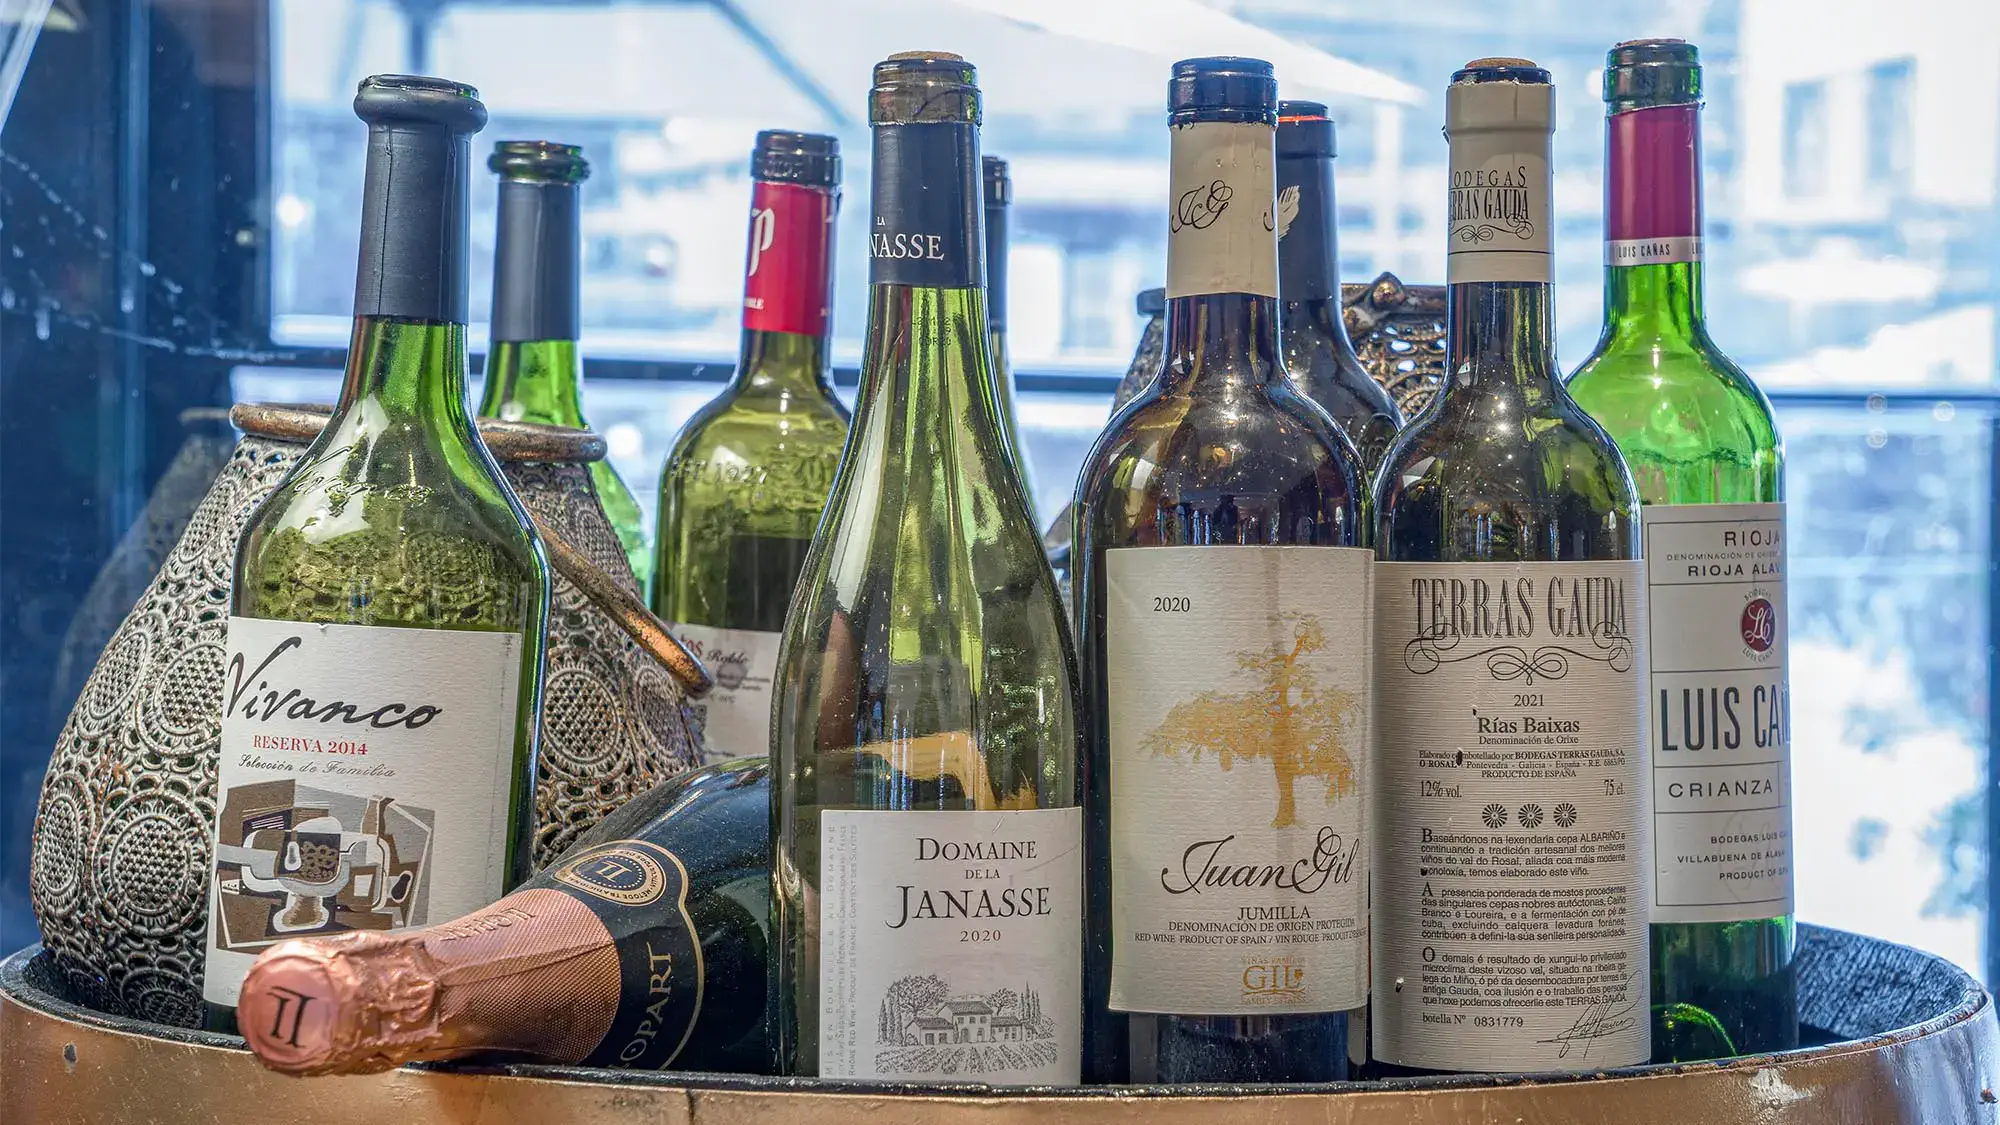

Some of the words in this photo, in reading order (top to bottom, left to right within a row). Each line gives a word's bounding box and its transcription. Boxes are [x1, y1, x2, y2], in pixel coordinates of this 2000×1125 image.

[1452, 166, 1527, 187] ODEGAS
[1451, 189, 1480, 221] RRAS
[1484, 188, 1529, 220] GAUDA
[876, 216, 886, 226] LA
[869, 233, 945, 261] NASSE
[1618, 246, 1636, 258] LUIS
[1641, 243, 1670, 257] CAÑAS
[1724, 530, 1780, 547] RIOJA
[1666, 551, 1741, 561] DENOMINACIÓN
[1688, 564, 1744, 576] RIOJA
[1154, 597, 1190, 612] 2020
[1412, 577, 1534, 638] TERRAS
[1547, 576, 1627, 638] GAUDA
[227, 636, 443, 730] Vivanco
[1514, 695, 1544, 707] 2021
[1661, 687, 1740, 751] LUIS
[1477, 717, 1517, 733] Rías
[1523, 717, 1580, 734] Baixas
[253, 735, 323, 753] RESERVA
[328, 740, 368, 755] 2014
[1479, 735, 1541, 745] Denominación
[1544, 736, 1554, 745] de
[1556, 735, 1579, 744] Orixe
[1419, 750, 1450, 759] Elaborado
[1515, 751, 1557, 760] BODEGAS
[1558, 750, 1590, 759] TERRAS
[239, 753, 293, 771] Selección
[299, 761, 318, 773] de
[322, 760, 396, 777] Familia
[1466, 761, 1508, 769] Pontevedra
[1518, 761, 1546, 769] Galicia
[1481, 770, 1529, 778] PRODUCTO
[1544, 767, 1577, 777] ESPAÑA
[1420, 780, 1443, 797] 12%
[1604, 779, 1614, 796] 75
[1669, 779, 1773, 798] CRIANZA
[1421, 828, 1488, 844] Baseándonos
[1491, 836, 1503, 844] na
[1505, 834, 1554, 844] lexendaria
[1556, 835, 1578, 845] cepa
[1710, 834, 1759, 844] BODEGAS
[1762, 832, 1777, 841] LUIS
[916, 838, 1037, 861] DOMAINE
[1421, 845, 1474, 854] continuando
[1489, 845, 1530, 854] tradición
[1534, 845, 1577, 854] artesanal
[1580, 844, 1595, 853] dos
[1161, 835, 1292, 894] Juan
[1292, 826, 1359, 893] Gil
[1421, 854, 1443, 864] viños
[1460, 855, 1473, 865] val
[1476, 856, 1488, 865] do
[1491, 856, 1522, 866] Rosal,
[1525, 855, 1553, 865] aliada
[1556, 857, 1573, 865] coa
[1575, 854, 1595, 863] máis
[1678, 853, 1747, 863] VILLABUENA
[1751, 852, 1762, 860] DE
[965, 869, 983, 880] DE
[985, 869, 1001, 880] LA
[1469, 868, 1498, 877] temos
[1500, 868, 1547, 877] elaborado
[1549, 868, 1568, 876] este
[1570, 866, 1589, 876] viño.
[1719, 870, 1764, 879] PRODUCT
[1441, 889, 1485, 898] presencia
[1487, 889, 1537, 899] ponderada
[1540, 889, 1551, 897] de
[1553, 888, 1584, 897] mostos
[885, 886, 1052, 929] JANASSE
[1439, 899, 1487, 909] singulares
[1489, 901, 1519, 910] cepas
[1521, 900, 1555, 909] nobres
[1237, 906, 1311, 921] JUMILLA
[1421, 907, 1451, 917] Branco
[1465, 910, 1507, 920] Loureira,
[1531, 910, 1588, 919] fermentación
[1169, 920, 1257, 932] DENOMINACIÓN
[1260, 923, 1274, 932] DE
[1276, 921, 1314, 931] ORIGEN
[1421, 920, 1446, 929] cuba,
[1452, 921, 1498, 929] excluindo
[1505, 922, 1549, 931] calquera
[1555, 920, 1593, 929] levadura
[960, 930, 1001, 942] 2020
[1135, 933, 1151, 942] RED
[1153, 933, 1175, 943] WINE
[1180, 935, 1224, 944] PRODUCT
[1226, 936, 1238, 944] OF
[1240, 935, 1267, 944] SPAIN
[1275, 935, 1290, 943] VIN
[1292, 934, 1319, 943] ROUGE
[1421, 930, 1466, 939] contribúen
[1423, 946, 1435, 962] O
[1442, 953, 1474, 963] demais
[1487, 955, 1530, 964] resultado
[1534, 955, 1545, 964] de
[1422, 964, 1465, 973] microclima
[1469, 965, 1493, 974] deste
[1497, 966, 1526, 974] vizoso
[1549, 965, 1579, 974] situado
[1422, 974, 1438, 984] lega
[1454, 975, 1477, 985] Miño,
[1501, 977, 1512, 985] da
[1515, 976, 1585, 985] desembocadura
[1422, 985, 1446, 995] antiga
[1449, 986, 1481, 997] Gauda,
[1504, 987, 1534, 996] ilusión
[1554, 986, 1585, 995] traballo
[1422, 996, 1437, 1006] que
[1439, 996, 1458, 1005] hoxe
[1460, 998, 1501, 1007] podemos
[1545, 999, 1564, 1007] este
[1565, 996, 1600, 1006] TERRAS
[1423, 1012, 1451, 1024] botella
[1474, 1016, 1523, 1027] 0831779
